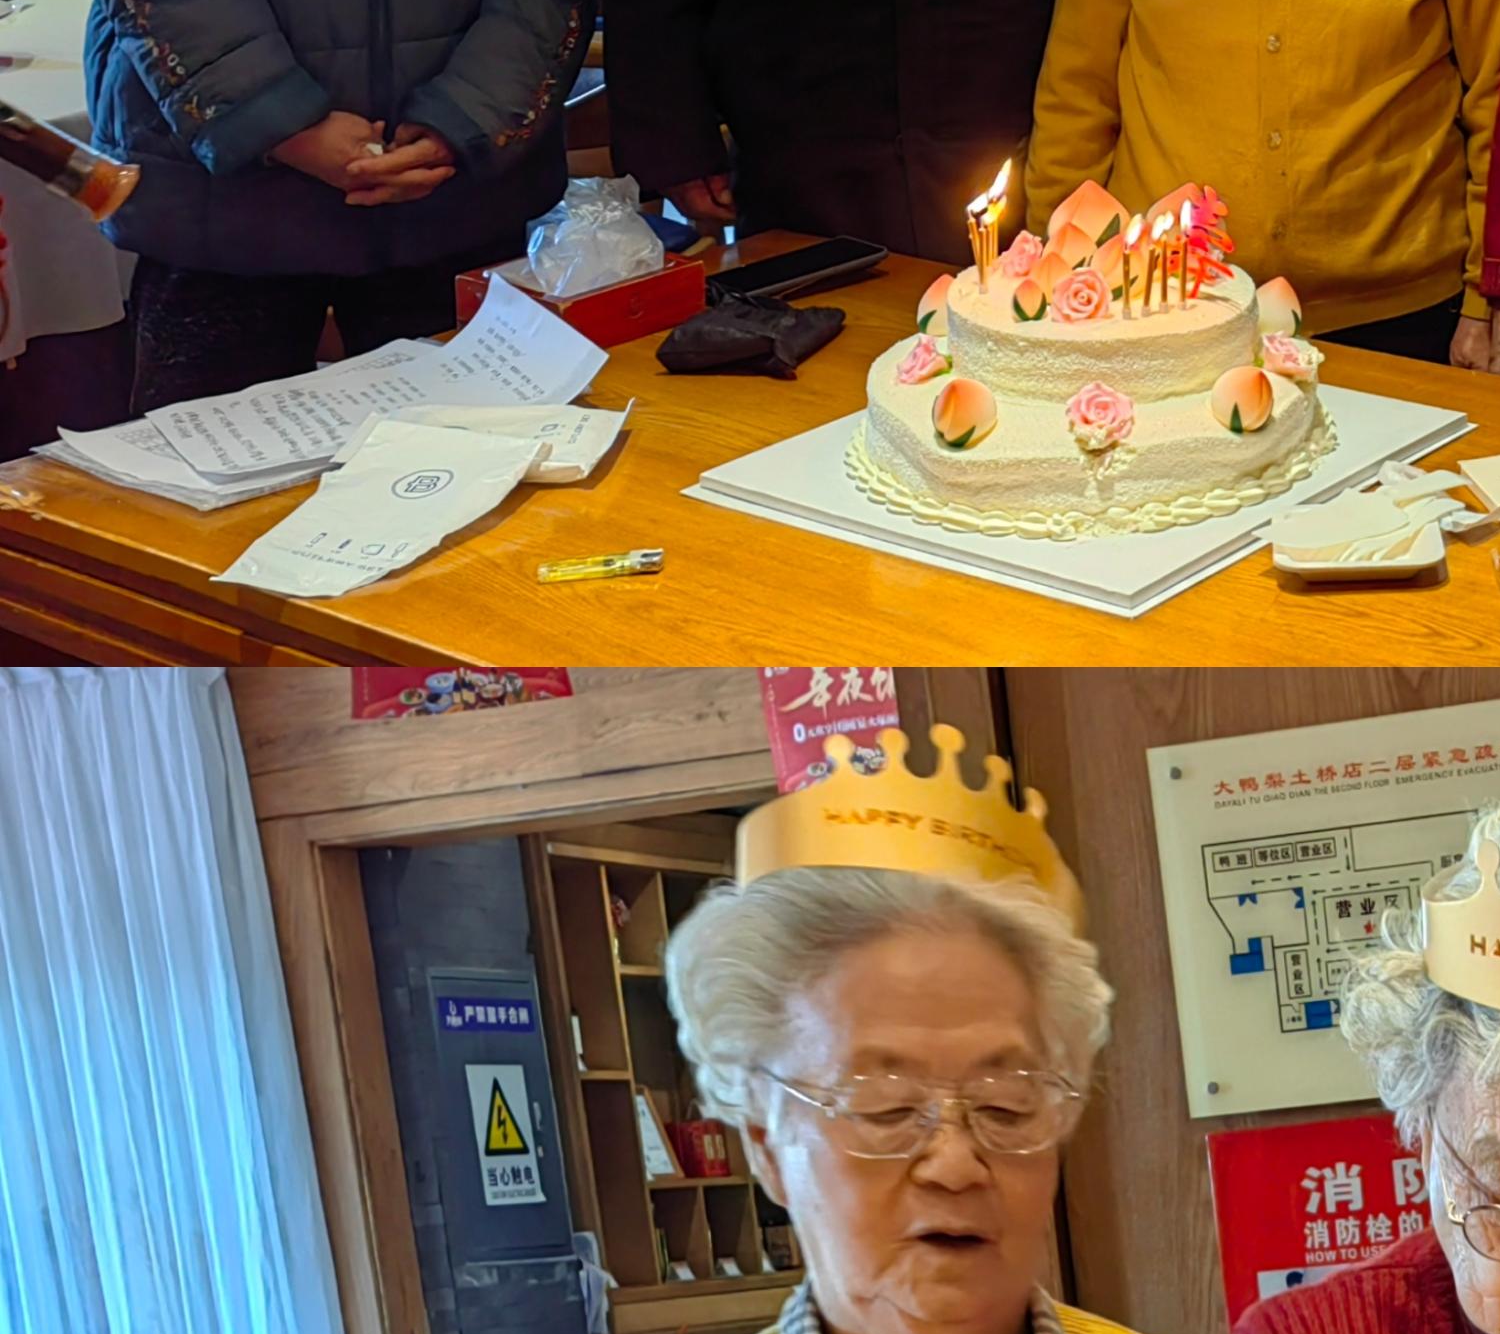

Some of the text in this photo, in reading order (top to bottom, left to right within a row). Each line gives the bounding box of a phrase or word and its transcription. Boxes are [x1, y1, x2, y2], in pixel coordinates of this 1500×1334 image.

[1249, 796, 1260, 804] TU
[1289, 790, 1311, 800] DIAN
[1314, 787, 1328, 796] THE
[1331, 783, 1362, 794] SECOND
[1364, 778, 1390, 789] FLOOR
[1395, 770, 1453, 785] EMERGENCY
[1258, 846, 1292, 862] 等位区
[1300, 843, 1333, 858] 营业区
[1335, 894, 1400, 918] 营业区
[487, 1165, 536, 1186] 当心触电
[1301, 1156, 1429, 1214] 消防
[1303, 1210, 1424, 1249] 消防栓的
[1305, 1250, 1337, 1265] HOW
[1341, 1247, 1358, 1260] TO
